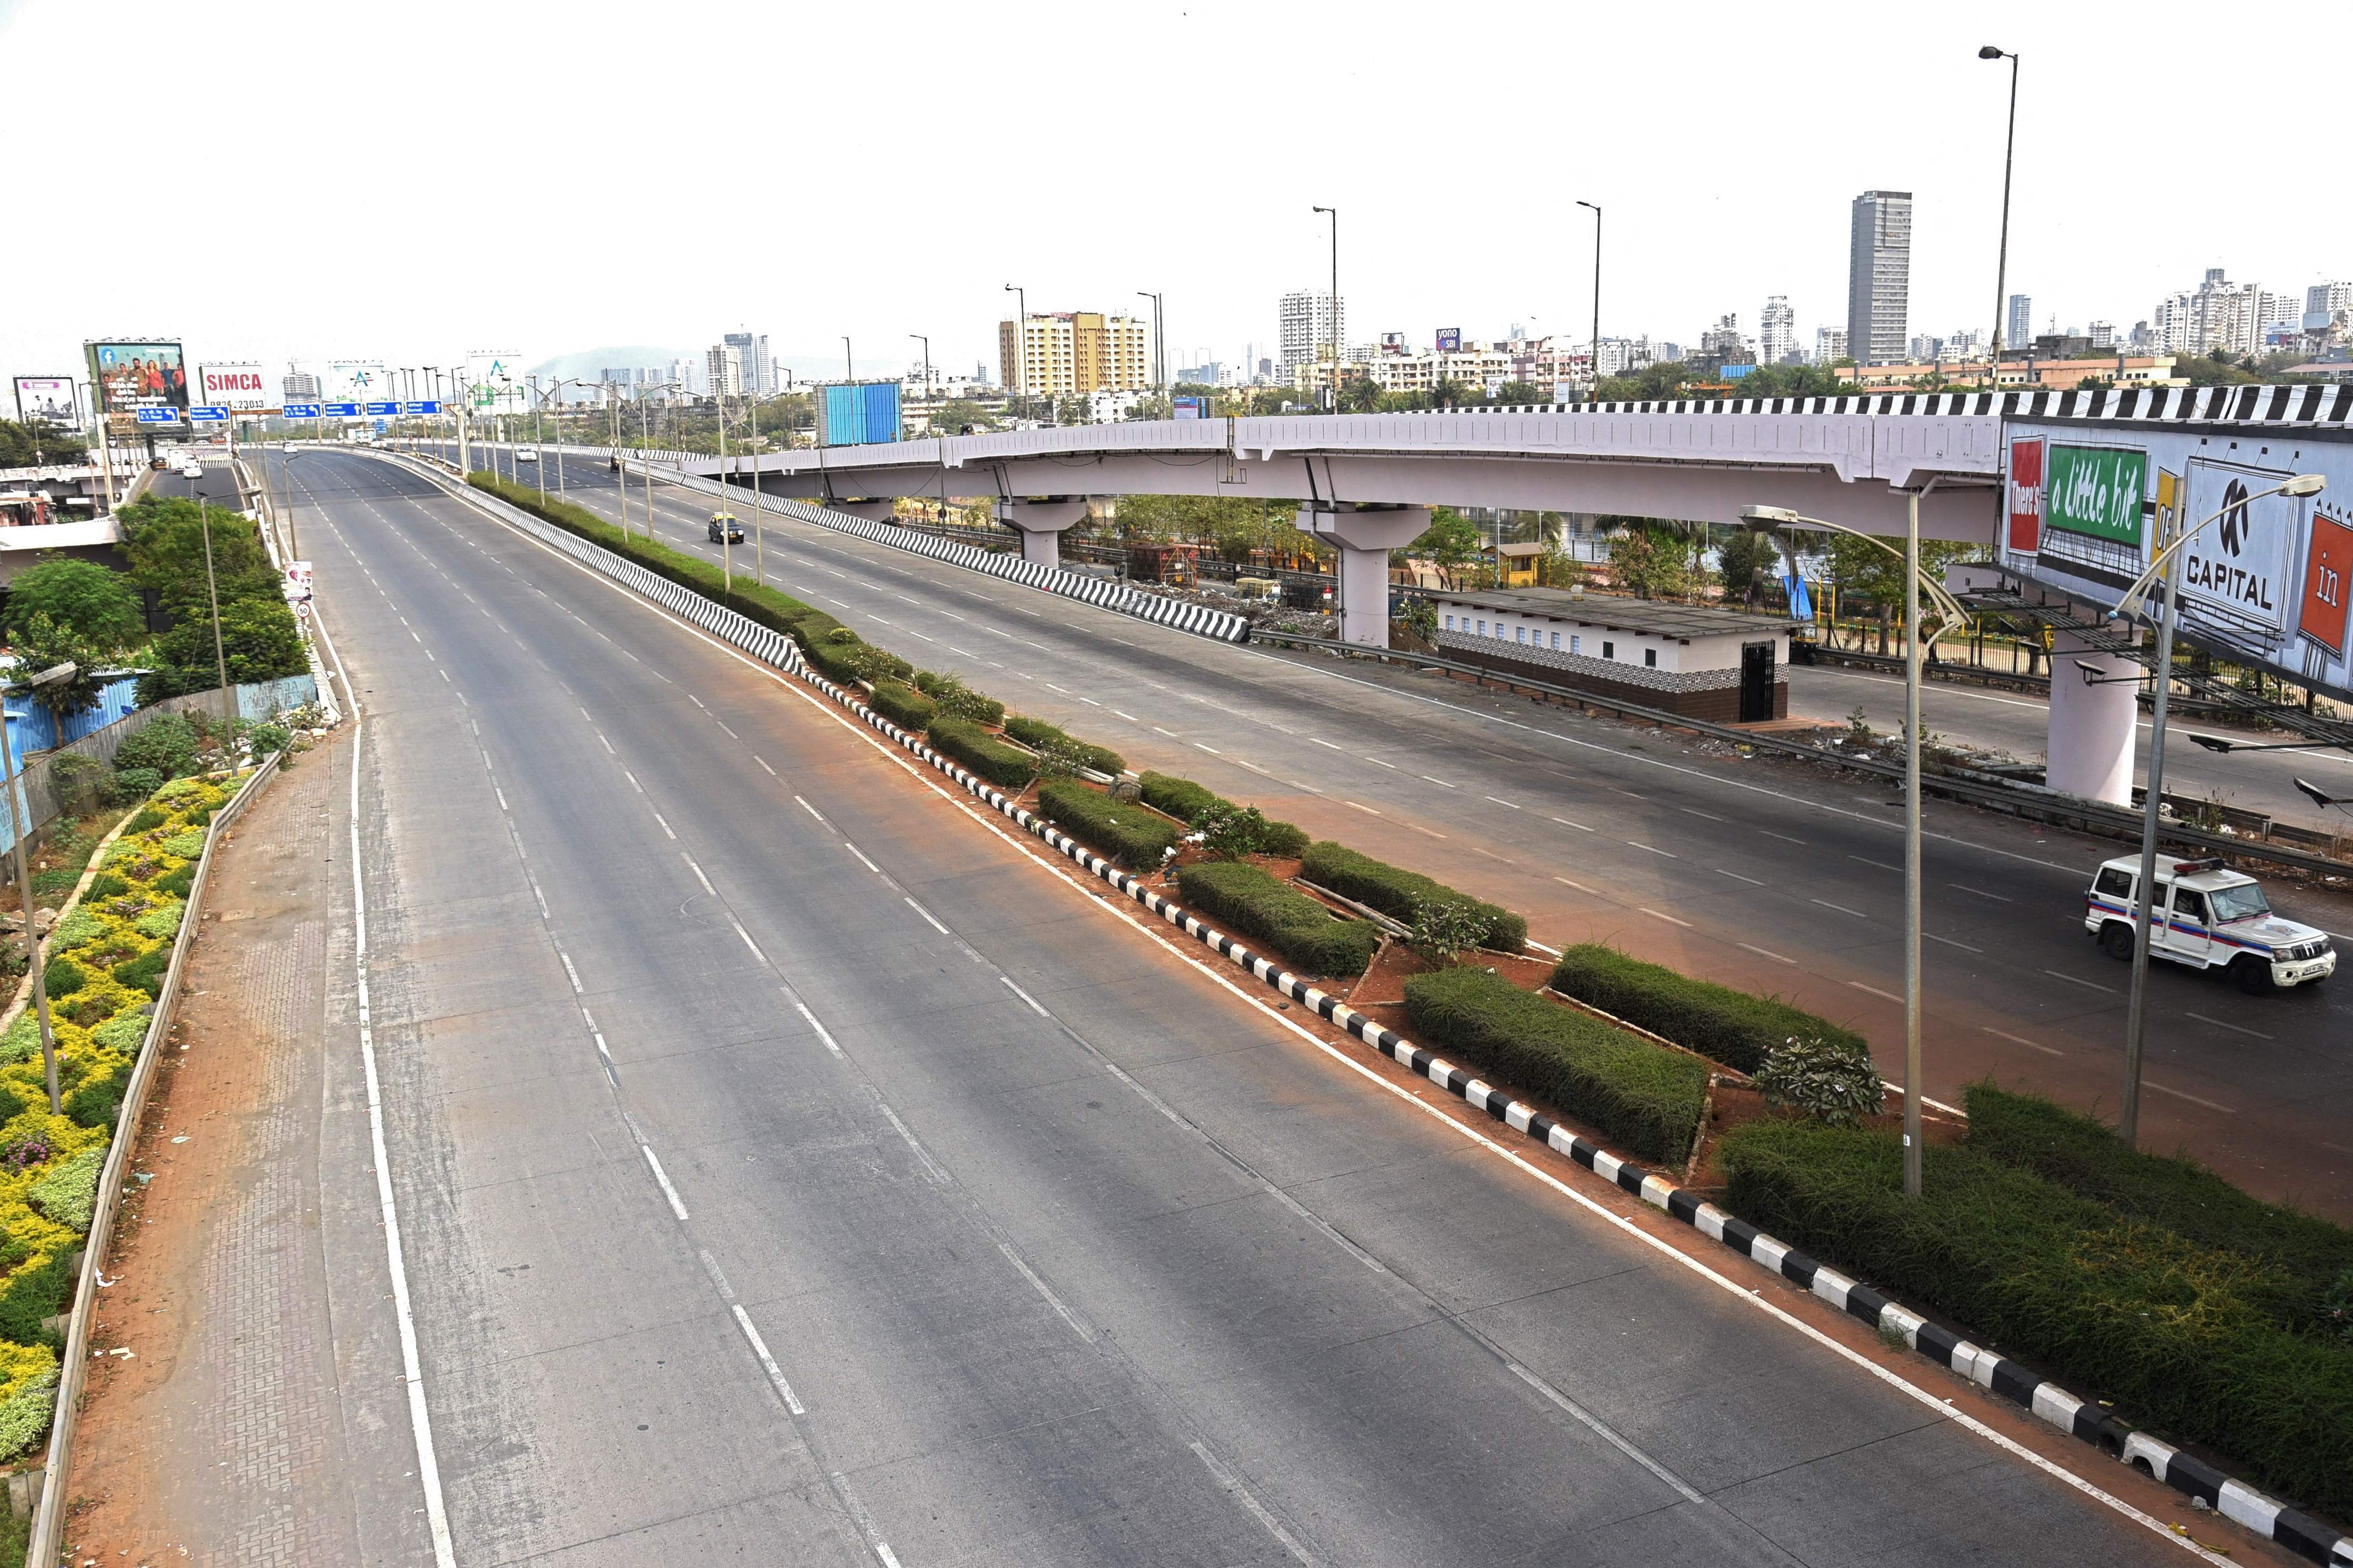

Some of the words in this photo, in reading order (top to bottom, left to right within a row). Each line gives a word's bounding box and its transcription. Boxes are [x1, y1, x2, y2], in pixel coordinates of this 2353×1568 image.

[1438, 329, 1457, 340] yono
[207, 374, 262, 390] SIMCA
[2012, 480, 2039, 516] There's
[2052, 478, 2060, 514] a
[2065, 453, 2107, 524] little
[2111, 456, 2137, 531] bit
[2187, 554, 2272, 611] CAPITAL
[2317, 551, 2338, 608] in
